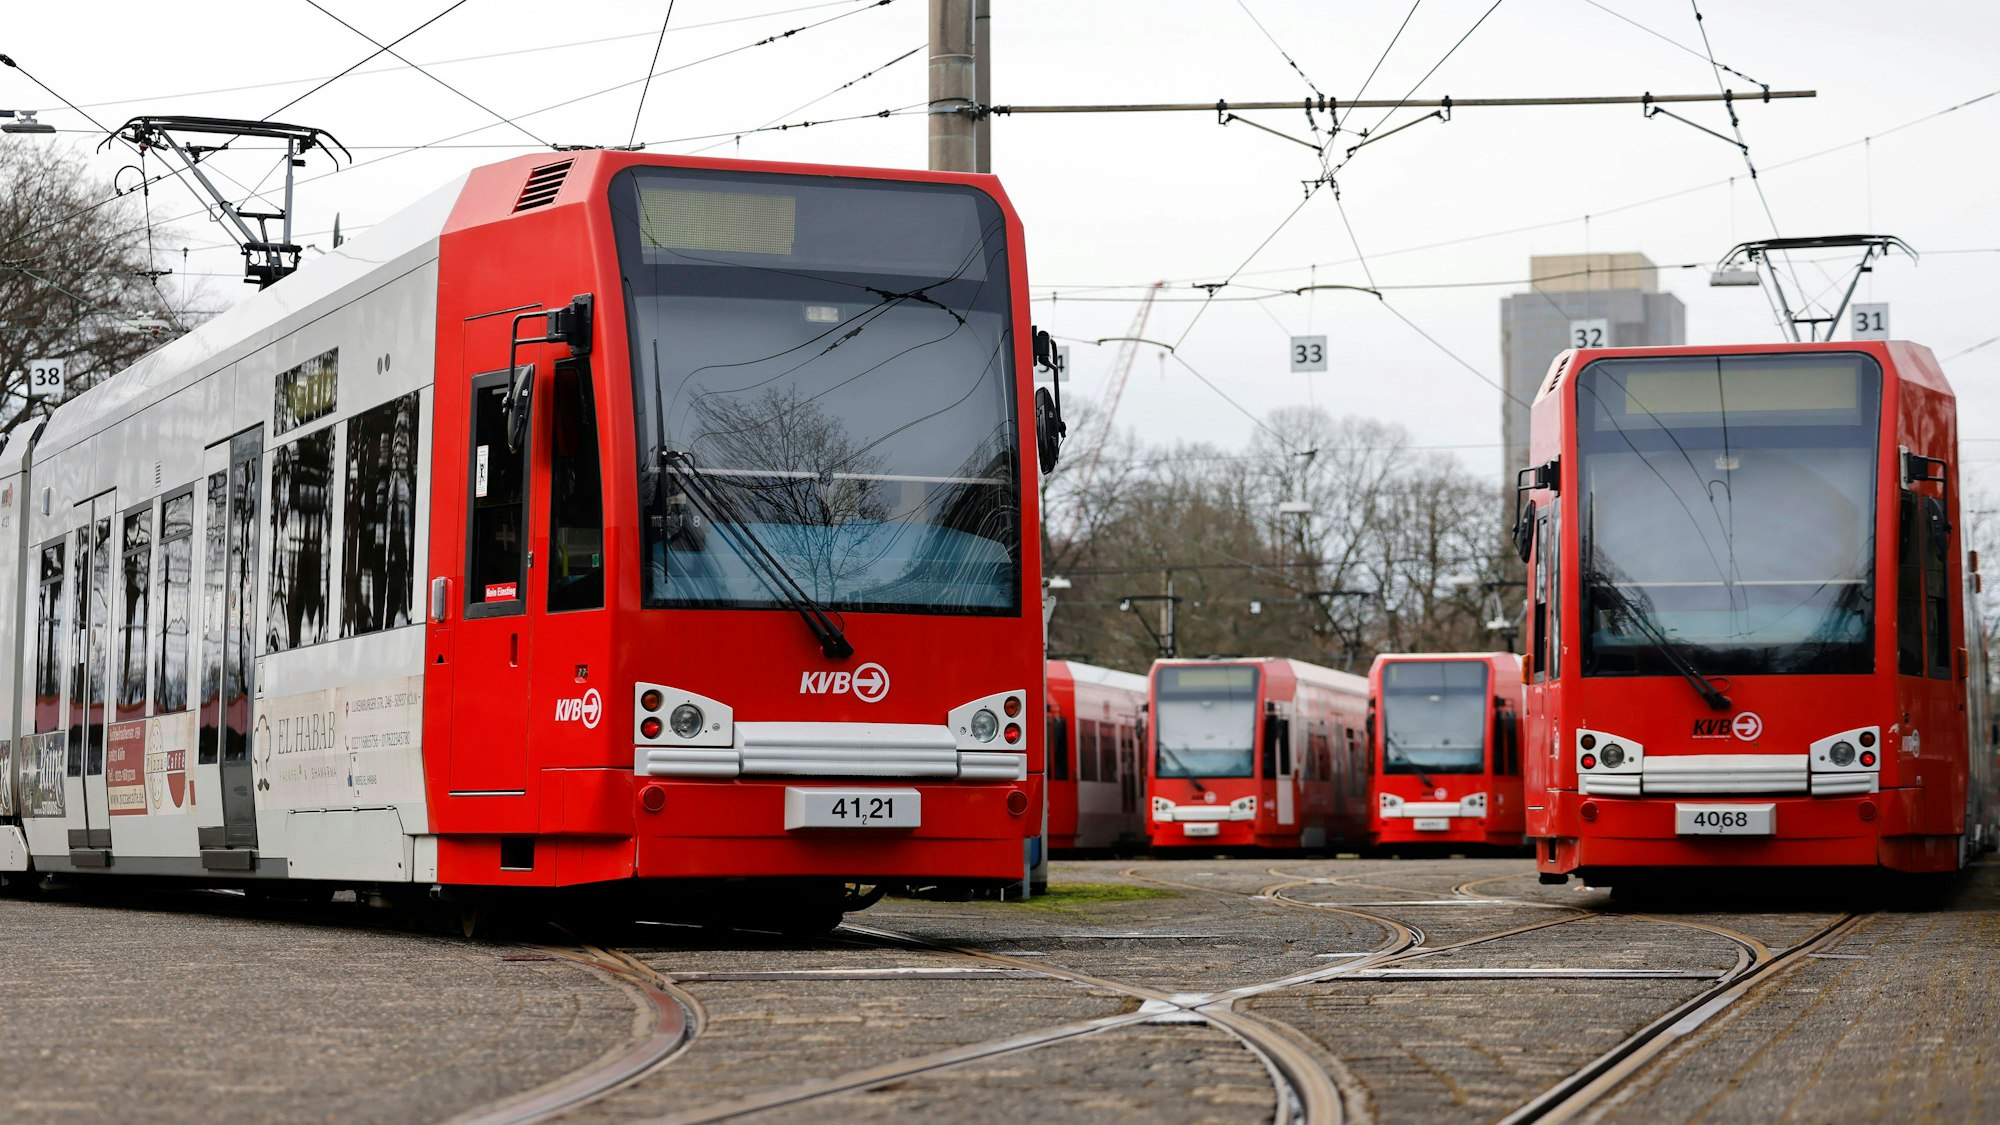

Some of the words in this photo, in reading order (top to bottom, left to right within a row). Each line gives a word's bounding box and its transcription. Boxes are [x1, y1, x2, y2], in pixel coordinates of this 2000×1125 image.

[1856, 312, 1884, 331] 31
[1575, 328, 1603, 348] 32
[1295, 344, 1322, 363] 33
[35, 367, 60, 386] 38
[486, 587, 497, 597] Kein
[497, 586, 516, 598] Einstieg
[800, 671, 851, 694] KVB
[555, 698, 582, 721] KVB
[278, 718, 293, 754] EL
[295, 711, 335, 752] HABAB
[1693, 719, 1732, 735] KVB
[147, 757, 163, 772] Pizza
[1694, 811, 1748, 827] 4068
